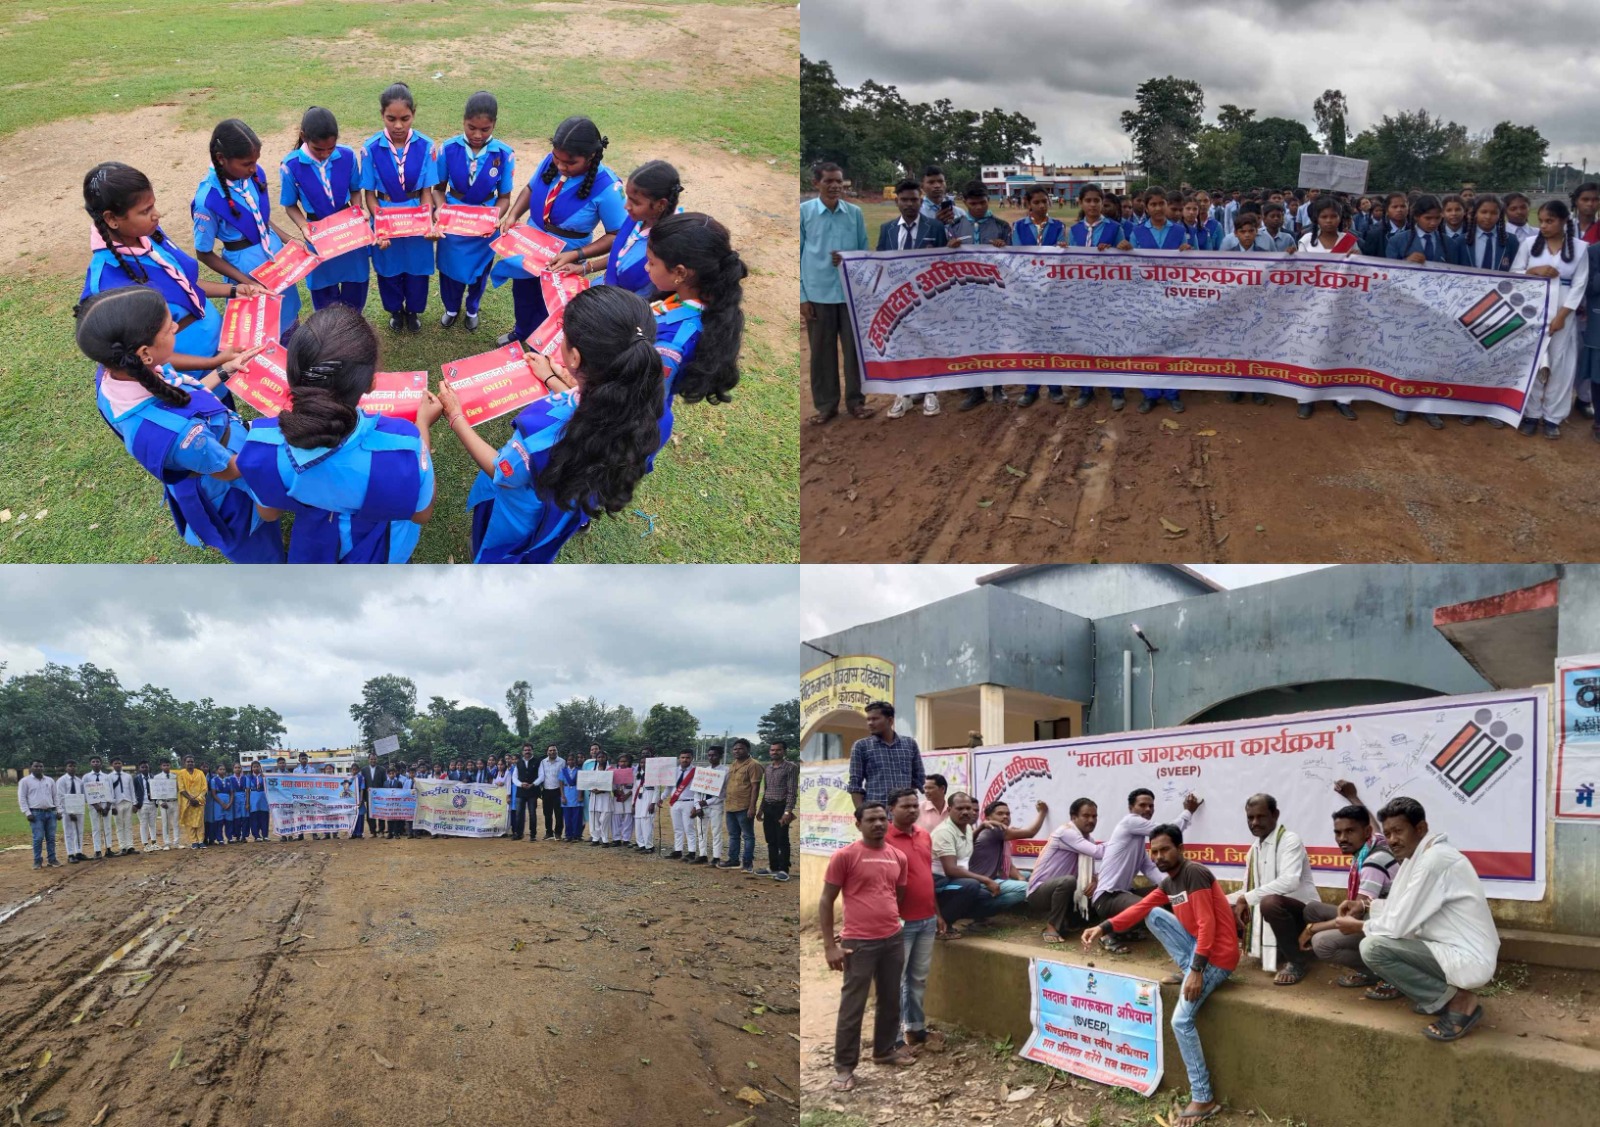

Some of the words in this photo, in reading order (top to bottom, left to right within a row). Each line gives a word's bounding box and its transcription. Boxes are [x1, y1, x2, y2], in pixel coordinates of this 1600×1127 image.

[915, 260, 1004, 294] अभियान
[1138, 264, 1264, 286] जागरूकता
[1165, 286, 1221, 300] (SVEEP)
[947, 358, 1017, 372] कलेक्टर
[1021, 355, 1046, 369] एवं
[1050, 356, 1091, 370] जिला
[1094, 358, 1160, 372] निर्वाचन
[482, 377, 513, 395] (SVEEP)
[1137, 740, 1235, 764] जागरूकता
[1005, 755, 1051, 779] अभियान
[1157, 765, 1201, 779] (SVEEP)
[452, 785, 471, 794] सेवा
[1042, 988, 1067, 1006] मतदाता
[1070, 995, 1113, 1016] जागरूकता
[1116, 1002, 1153, 1025] अभियान
[1073, 1015, 1110, 1035] (SVEEP)
[1081, 1034, 1091, 1044] का
[1115, 1042, 1149, 1062] अभियान
[1120, 1061, 1148, 1078] मतदान
